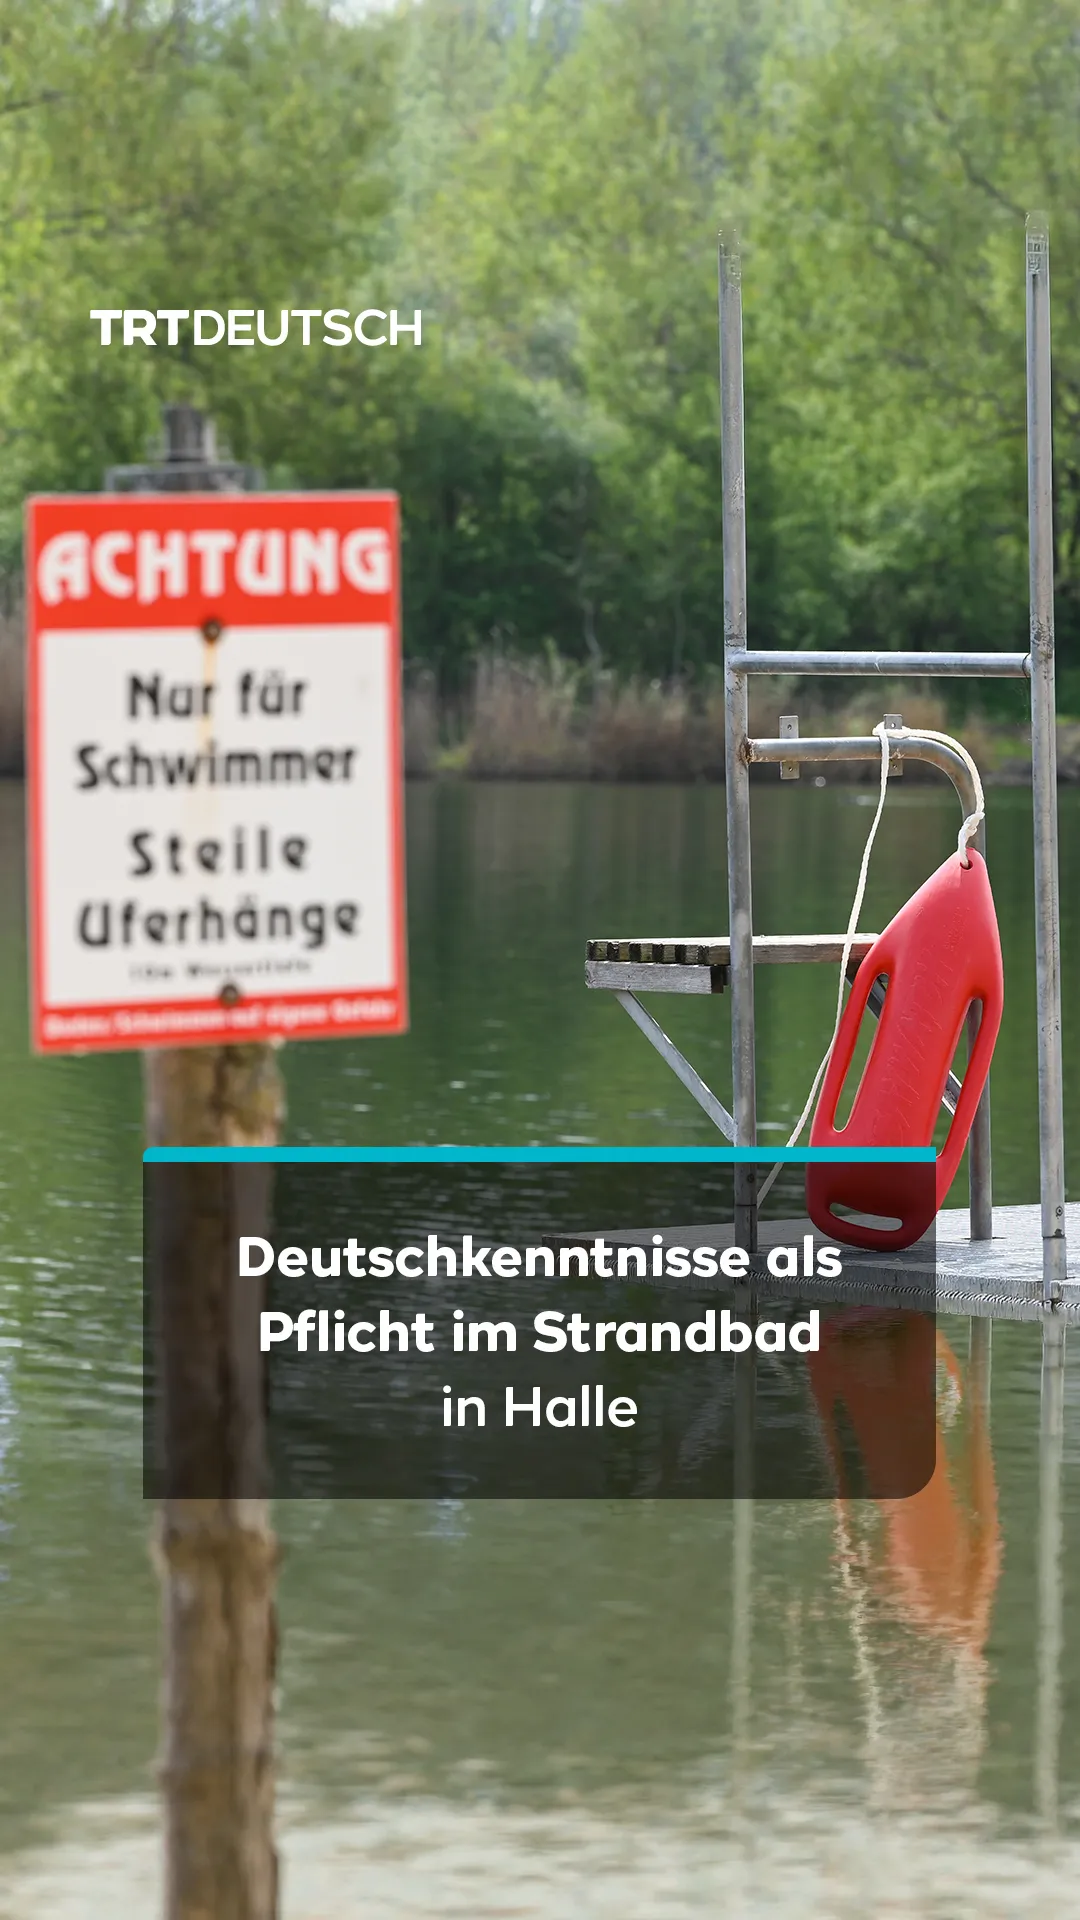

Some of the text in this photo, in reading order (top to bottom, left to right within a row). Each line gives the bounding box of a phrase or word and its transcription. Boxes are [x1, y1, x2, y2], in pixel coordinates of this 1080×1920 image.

[37, 527, 392, 605] ACHTUNG
[127, 669, 307, 719] Nur für
[75, 742, 357, 791] Schwimmer
[129, 826, 308, 877] Steile
[77, 895, 360, 950] Uferhänge
